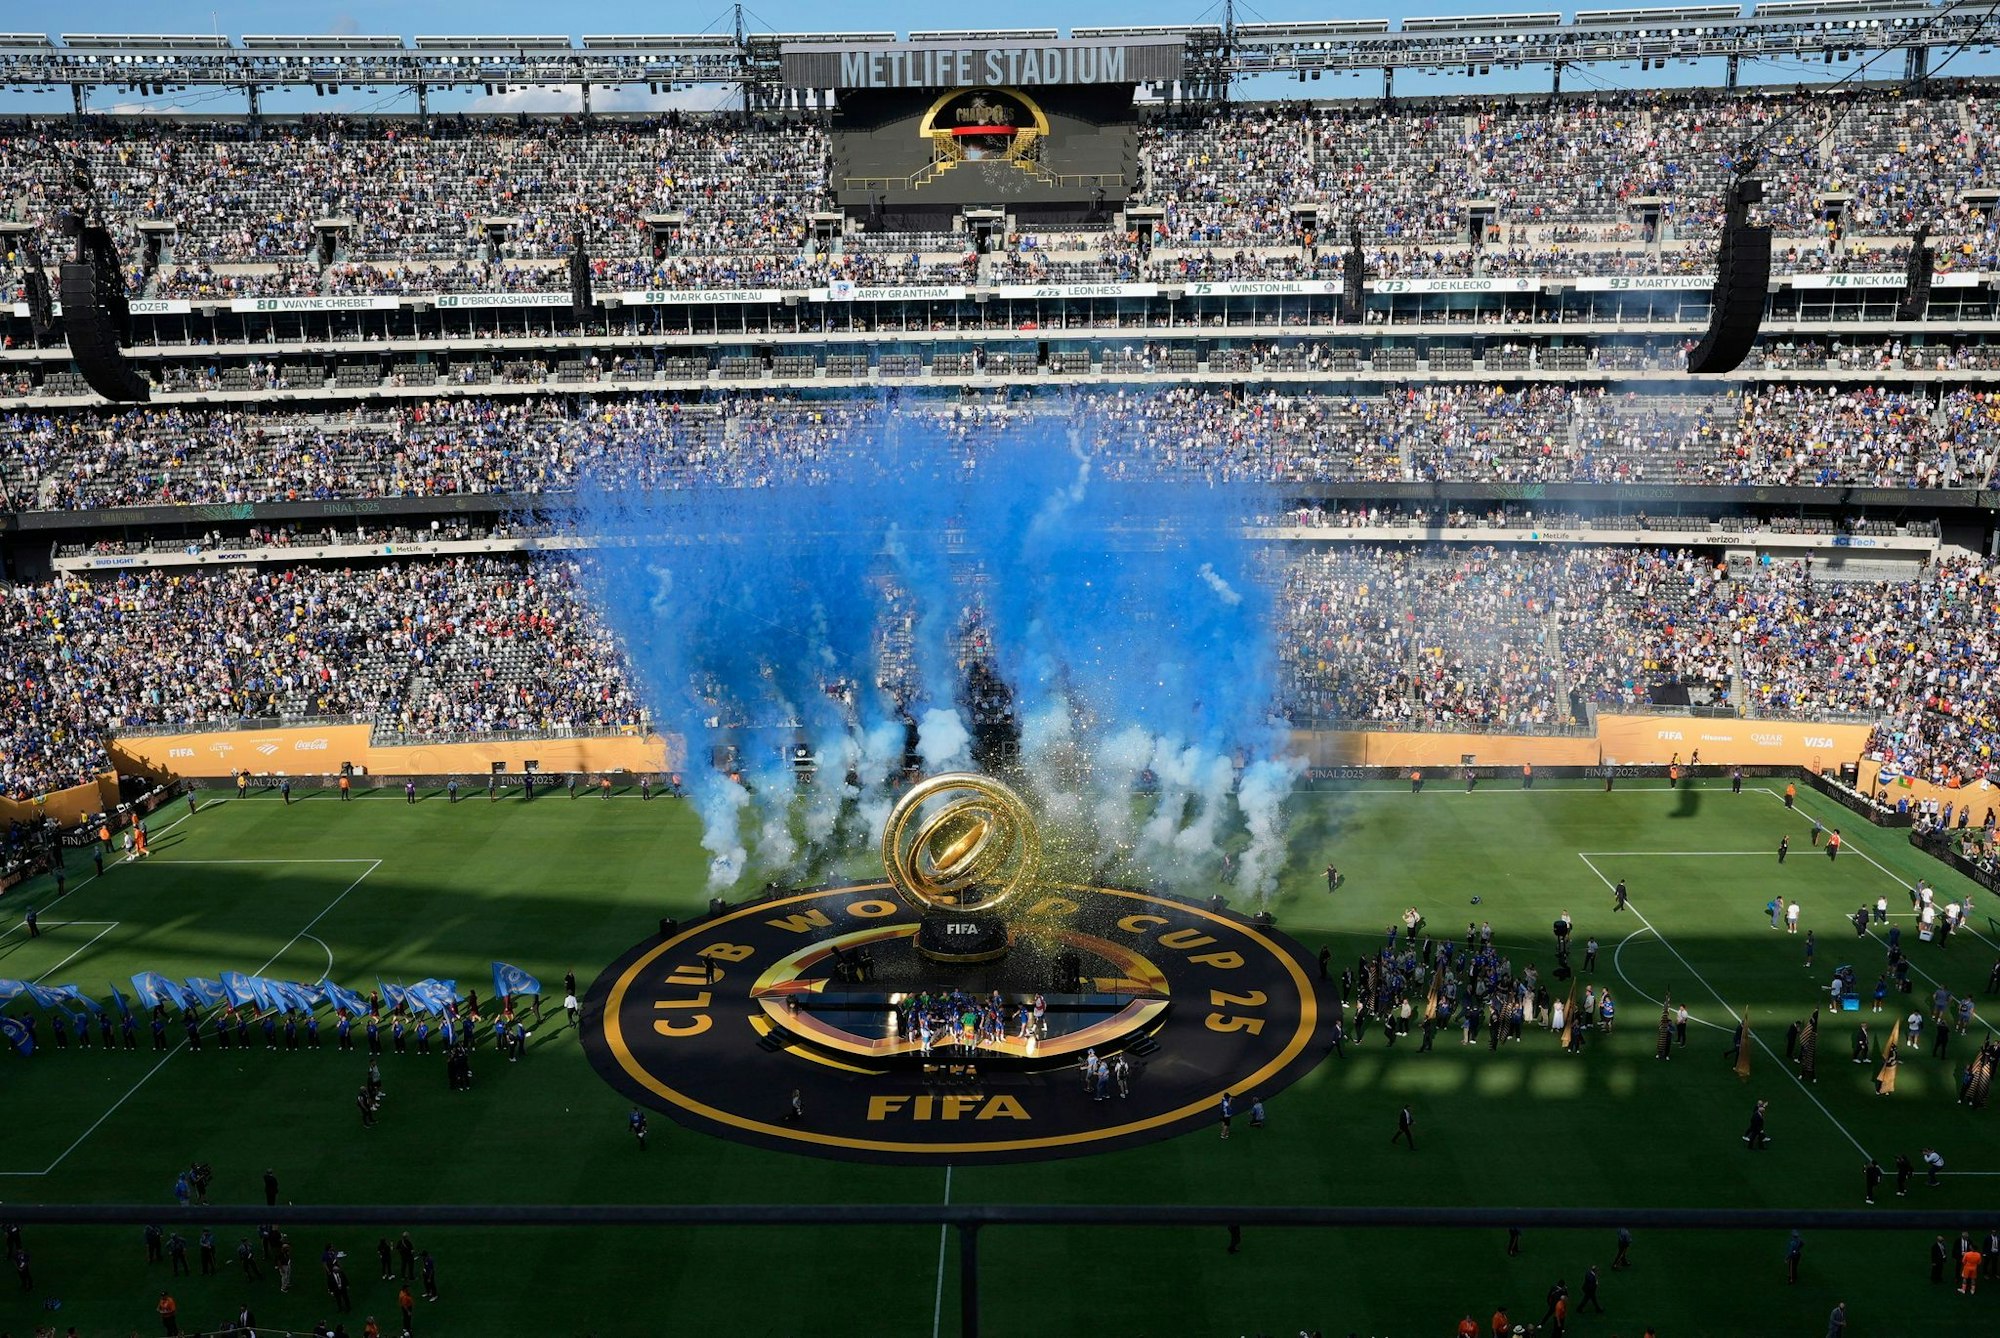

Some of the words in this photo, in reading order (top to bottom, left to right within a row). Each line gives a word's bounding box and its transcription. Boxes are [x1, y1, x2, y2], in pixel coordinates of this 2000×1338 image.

[841, 49, 973, 88] METLIFE
[984, 46, 1125, 86] STADIUM
[1384, 281, 1403, 292] 73
[1426, 281, 1448, 290] JOE
[1451, 280, 1490, 289] KLECKO
[1608, 278, 1629, 289] 93
[1635, 277, 1678, 288] MARTY
[1680, 276, 1715, 287] LYONS
[1826, 276, 1847, 287] 74
[1853, 275, 1879, 286] NICK
[858, 289, 885, 299] ARRY
[888, 288, 948, 298] GRANTHAM
[1031, 287, 1060, 297] JETS
[1067, 286, 1093, 295] LEON
[1095, 285, 1121, 295] HESS
[1194, 284, 1212, 295] 75
[1230, 284, 1279, 293] WINSTON
[1281, 283, 1303, 292] HILL
[438, 295, 458, 307] 60
[462, 294, 539, 306] D'BRICKASHAW
[541, 293, 573, 305] FERGU
[645, 292, 665, 303] 99
[670, 293, 701, 302] MARK
[704, 291, 762, 302] GASTINEAU
[130, 302, 169, 312] OOZER
[257, 299, 278, 310] 80
[282, 299, 323, 309] WAYNE
[325, 297, 374, 308] CHREBET
[1615, 488, 1647, 498] FINAL
[1648, 488, 1674, 499] 2025
[323, 503, 354, 514] FINAL
[356, 502, 380, 512] 2025
[1542, 532, 1569, 540] MetLife
[1705, 534, 1739, 544] verizon
[396, 545, 423, 553] MetLife
[1657, 731, 1683, 741] FIFA
[1751, 733, 1783, 742] QATAR
[1804, 737, 1834, 748] VISA
[169, 747, 195, 758] FIFA
[1341, 769, 1364, 778] 2025
[1585, 768, 1608, 777] FINA
[1616, 768, 1639, 777] 2025
[246, 777, 266, 787] NAL
[501, 776, 526, 785] FINA
[531, 775, 554, 785] 2025
[946, 923, 979, 935] FIFA
[653, 942, 755, 1037] CLUB
[1116, 914, 1245, 970] CUP
[1204, 988, 1268, 1036] 25
[866, 1094, 1033, 1121] FIFA
